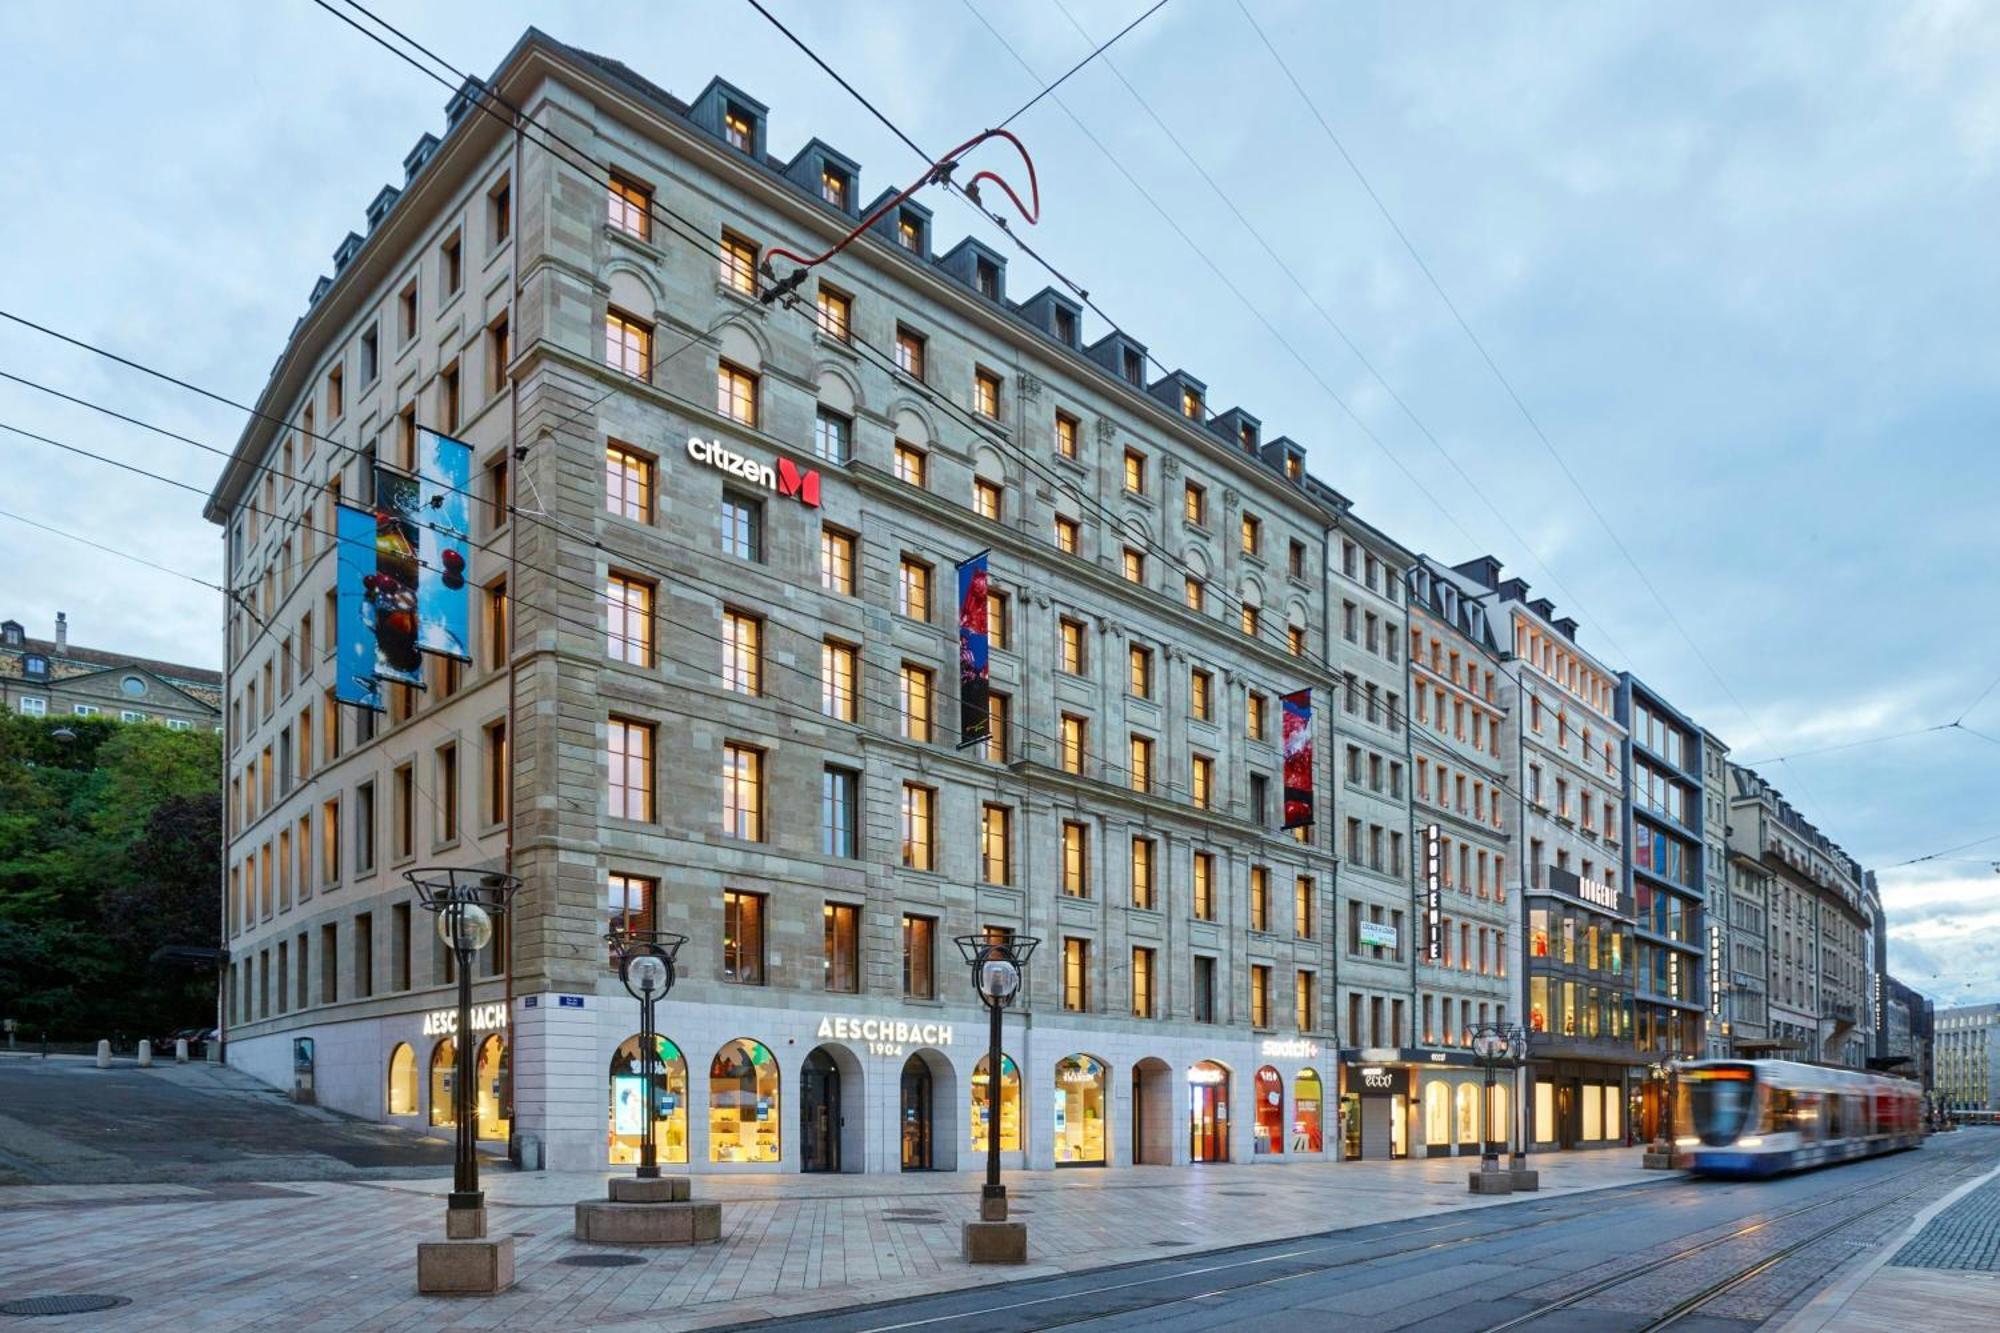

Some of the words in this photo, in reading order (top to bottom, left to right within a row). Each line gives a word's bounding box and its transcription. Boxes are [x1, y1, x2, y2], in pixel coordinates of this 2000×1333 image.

[687, 437, 821, 508] citizenM
[423, 1003, 507, 1035] AESCACH
[817, 1016, 953, 1045] AESCHBACH
[869, 1042, 903, 1056] 1904
[1365, 1074, 1392, 1088] ecco
